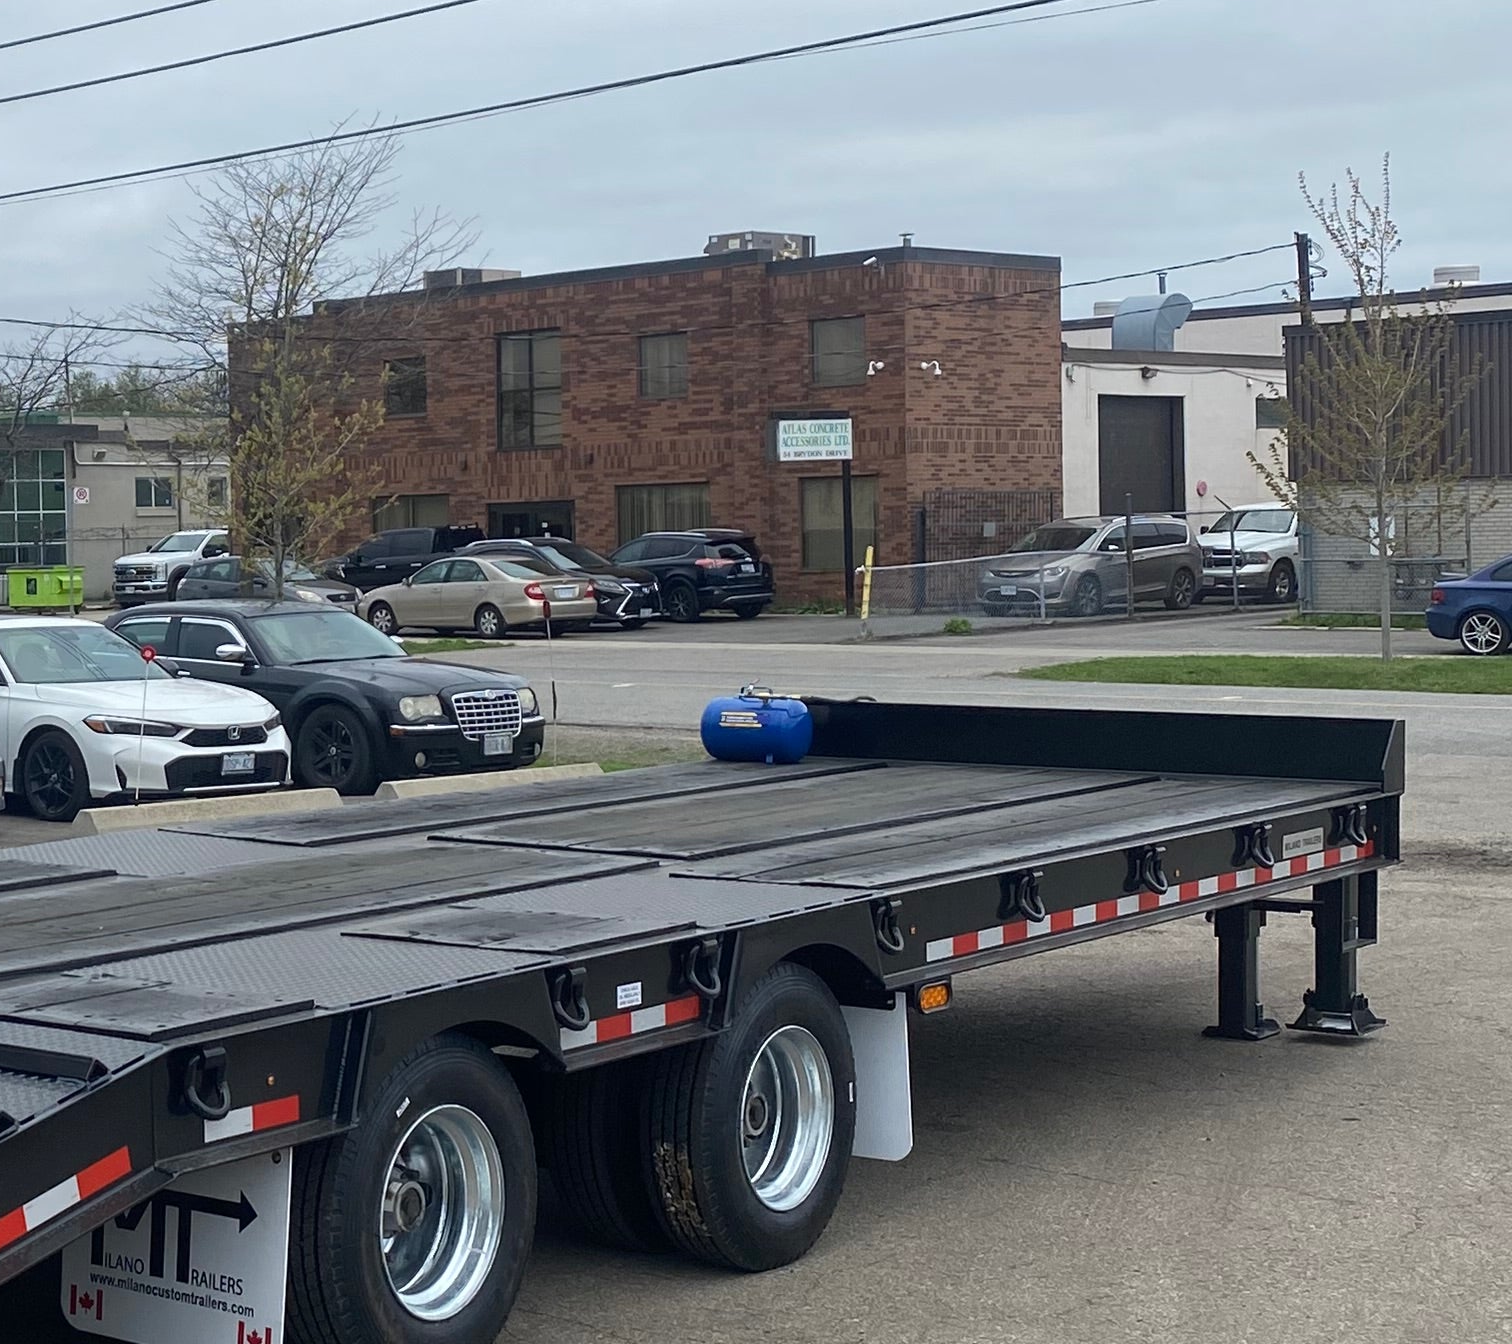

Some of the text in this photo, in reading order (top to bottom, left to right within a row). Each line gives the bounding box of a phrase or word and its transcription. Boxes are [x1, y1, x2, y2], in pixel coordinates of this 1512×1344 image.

[782, 422, 849, 434] ATLAS CONCRETE
[781, 434, 851, 447] ACCESSORIES LTD.
[825, 449, 847, 457] DRIVE
[89, 1271, 256, 1318] www.milanocustomtrailers.com
